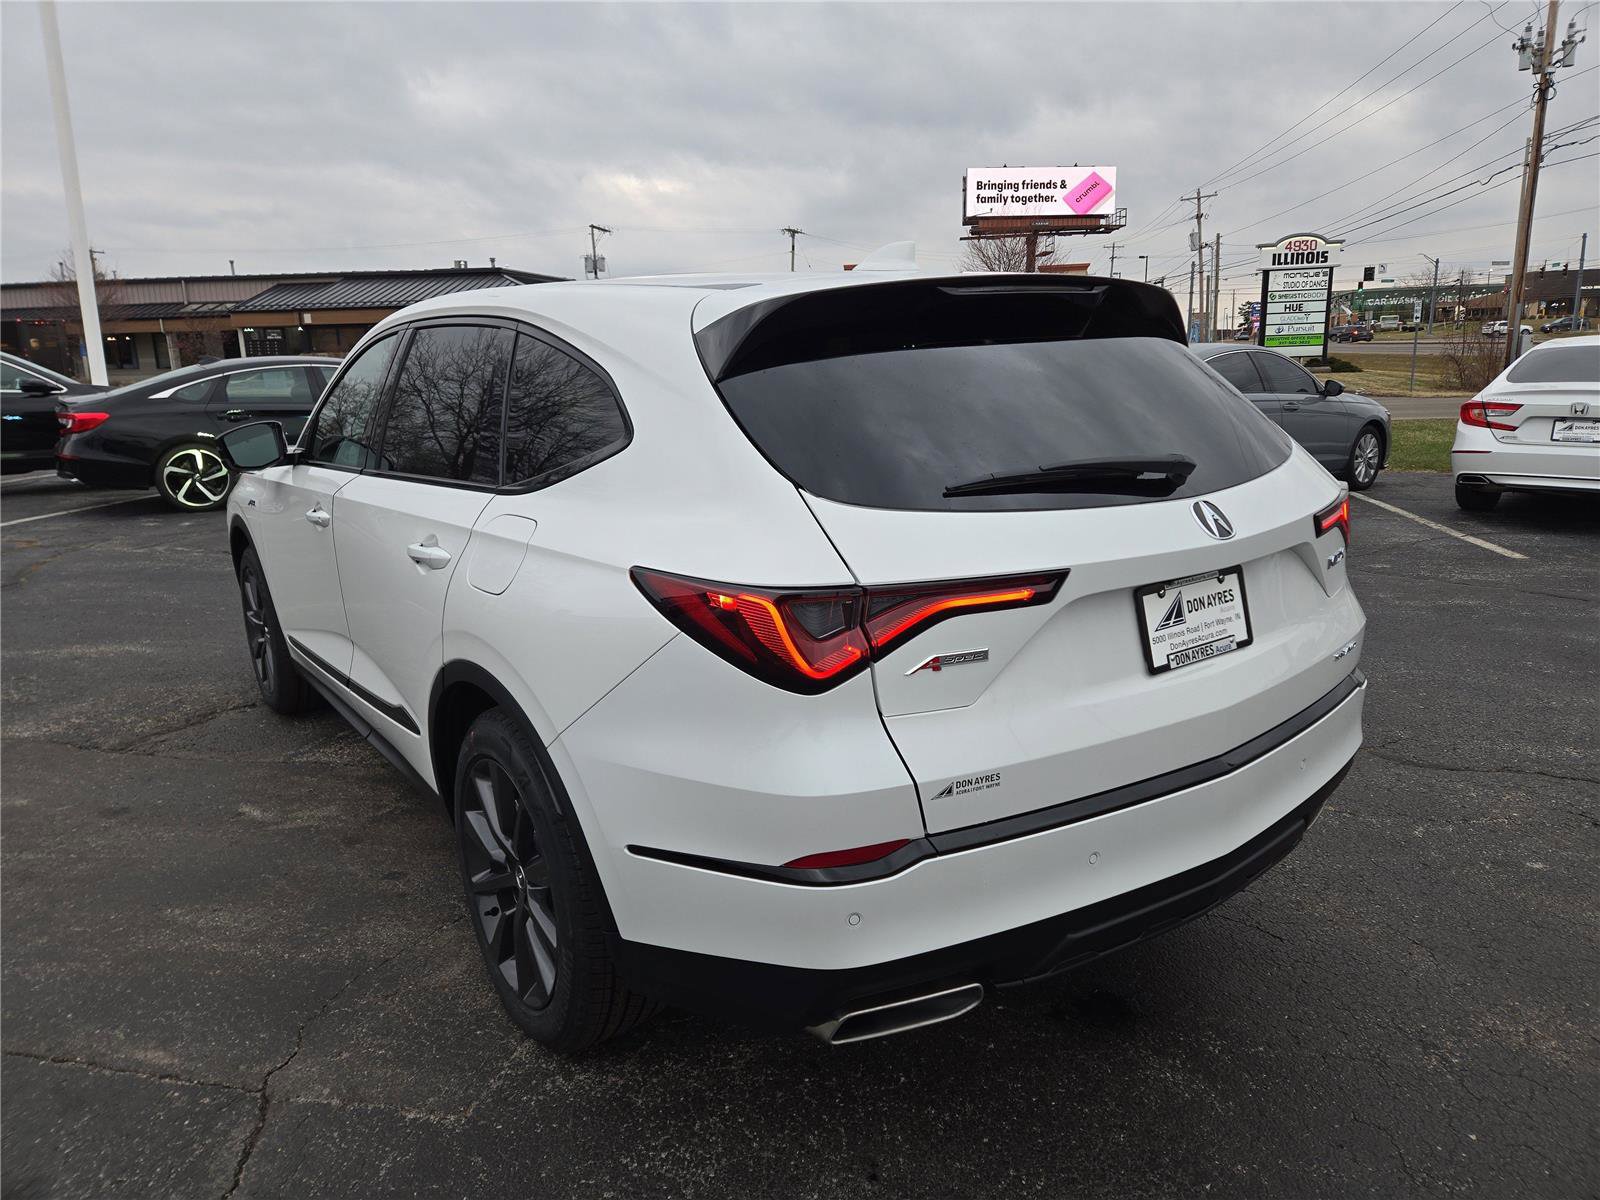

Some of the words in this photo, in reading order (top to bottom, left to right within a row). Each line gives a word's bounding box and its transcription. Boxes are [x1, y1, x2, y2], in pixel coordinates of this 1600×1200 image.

[976, 179, 1019, 192] Bringing
[1021, 180, 1057, 190] friends
[1059, 180, 1067, 190] &
[976, 193, 1008, 205] family
[1010, 193, 1057, 206] together.
[1284, 239, 1318, 252] 4930
[1272, 251, 1329, 266] ILLINOIS
[1283, 281, 1300, 289] STUDIO
[1302, 280, 1309, 288] OF
[1310, 279, 1328, 288] DANCE
[1284, 303, 1304, 312] HUE
[1368, 298, 1387, 306] CAR
[1390, 296, 1416, 305] WASH
[1287, 325, 1315, 333] Pursuit
[1186, 596, 1206, 614] DON
[1207, 588, 1235, 609] AYRES
[1152, 634, 1167, 646] 5000
[1167, 630, 1186, 641] Illinois
[1186, 625, 1201, 635] Road
[1204, 621, 1215, 630] Fort
[1170, 628, 1228, 651] DonAyresAcura.com
[1215, 643, 1232, 654] Acura
[955, 778, 973, 789] DON
[974, 773, 1001, 786] AYRES
